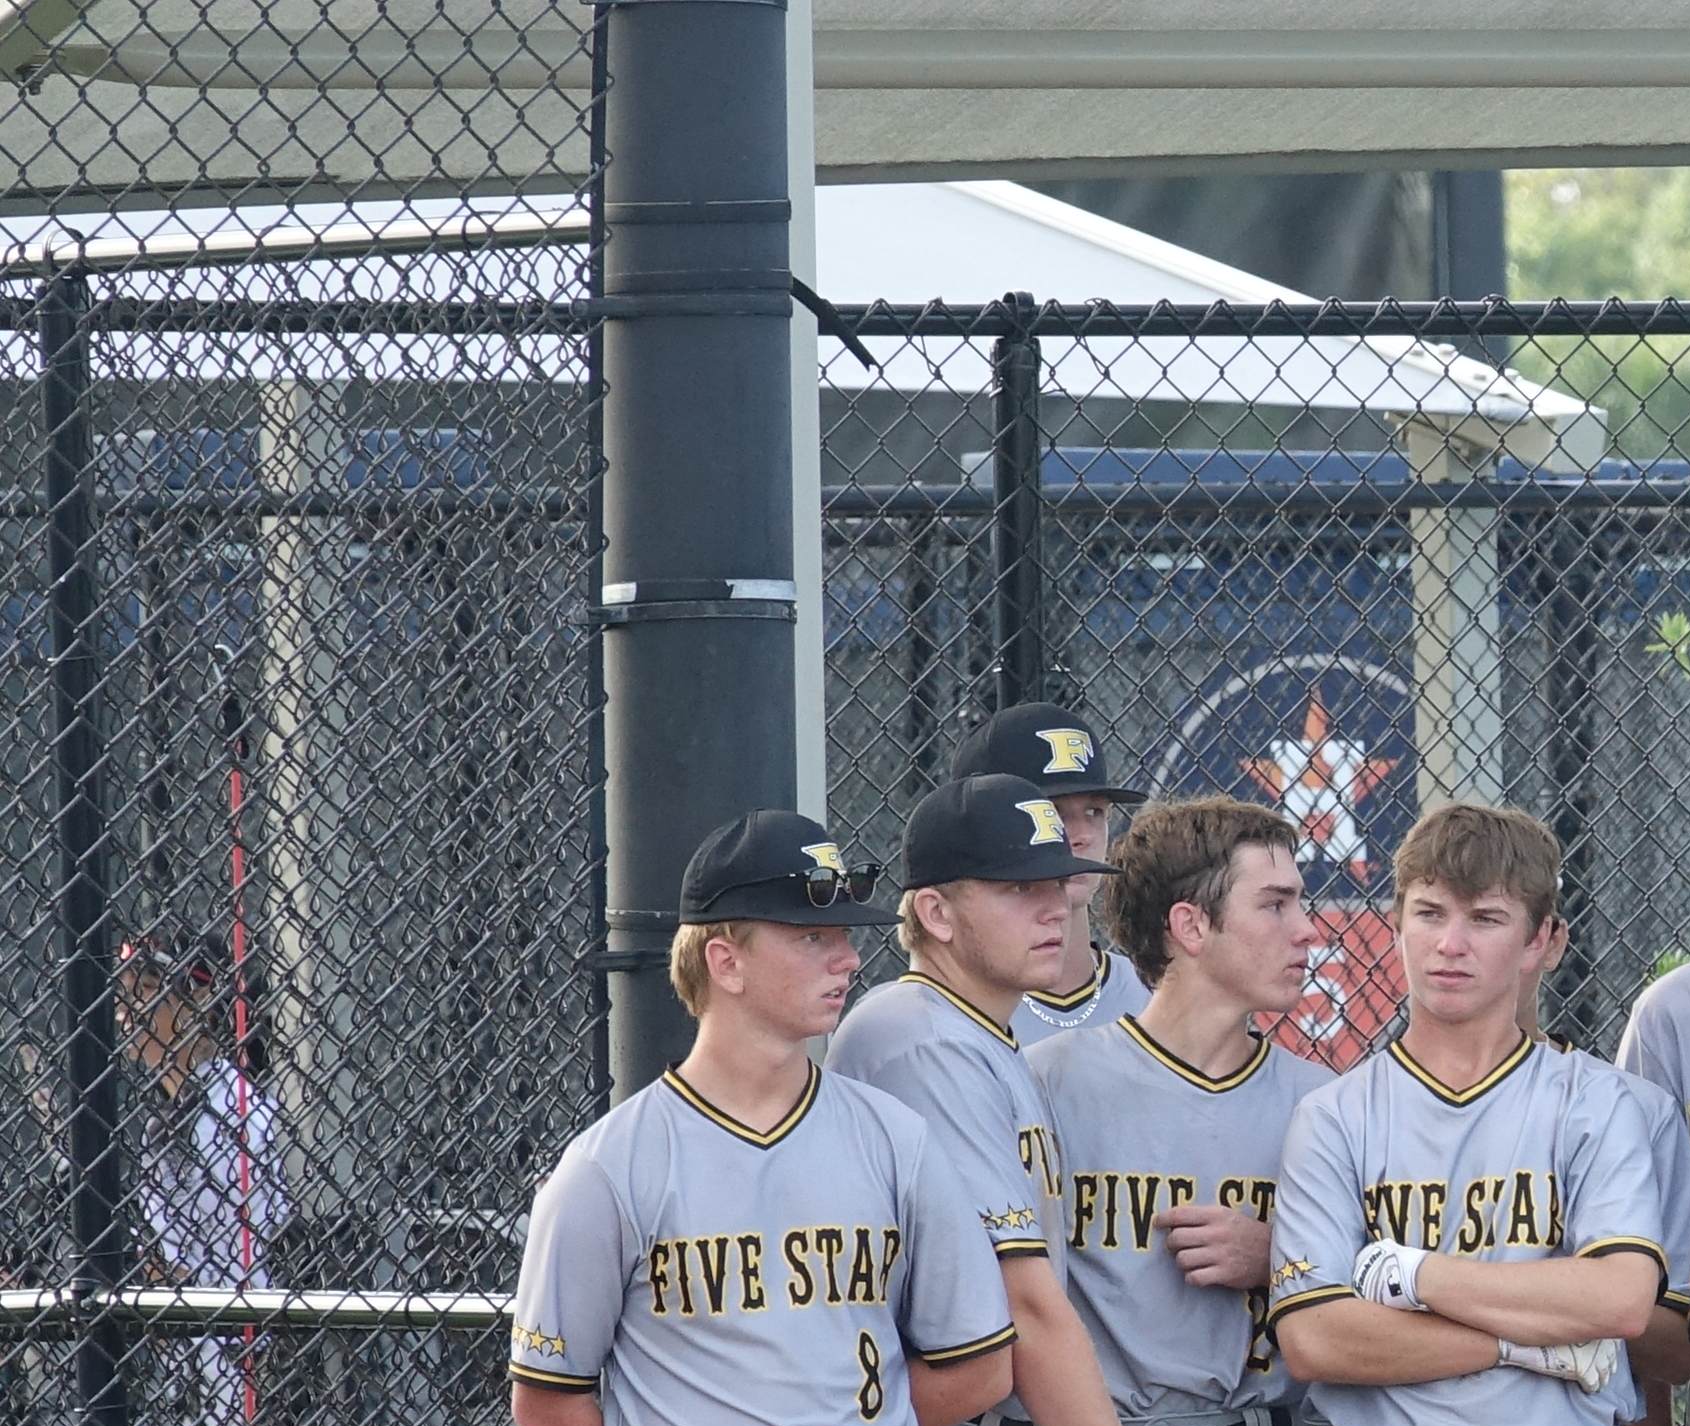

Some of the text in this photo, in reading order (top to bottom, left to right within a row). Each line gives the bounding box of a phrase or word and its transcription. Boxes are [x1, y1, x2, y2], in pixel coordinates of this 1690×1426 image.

[647, 1226, 902, 1317] FIVE STAR
[855, 1328, 884, 1422] 8
